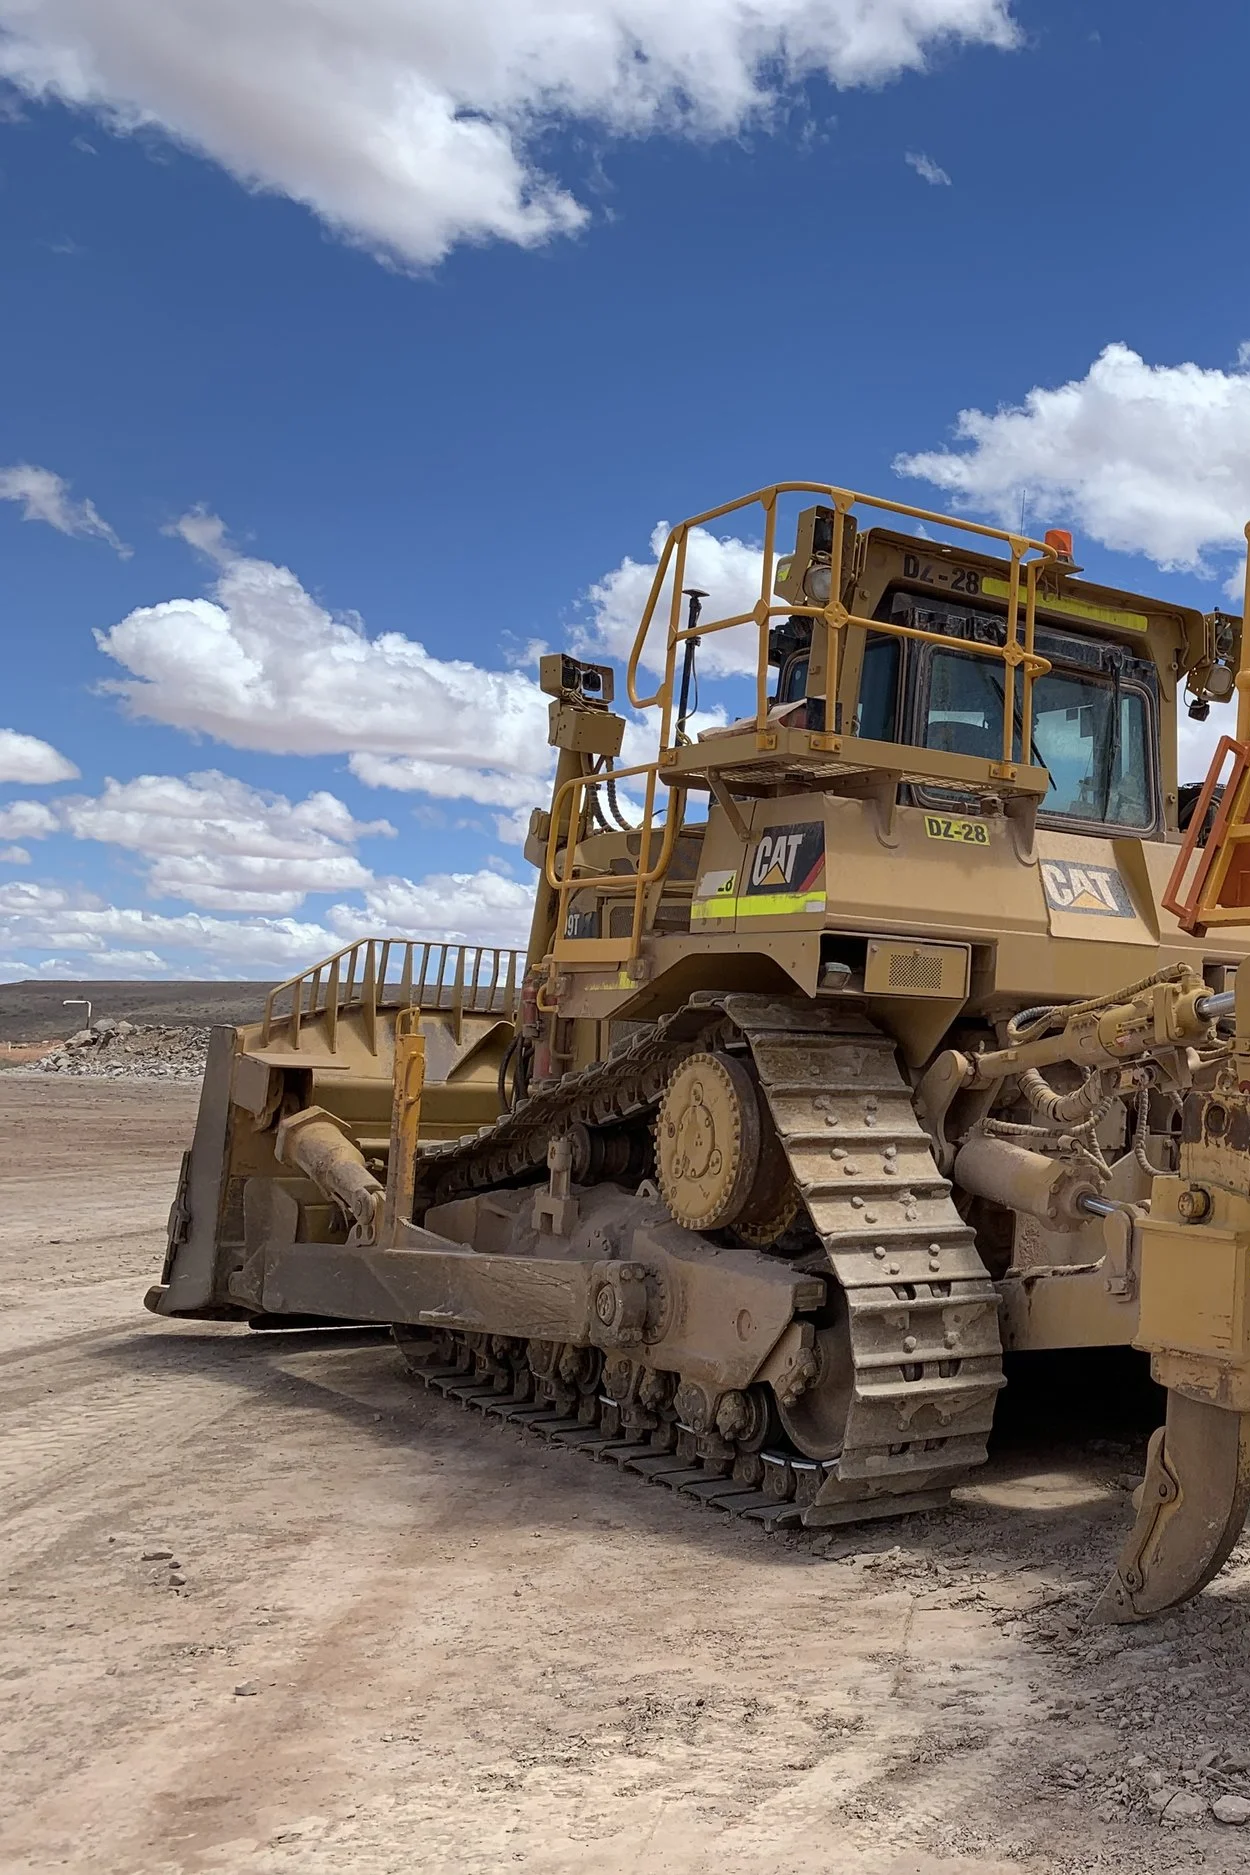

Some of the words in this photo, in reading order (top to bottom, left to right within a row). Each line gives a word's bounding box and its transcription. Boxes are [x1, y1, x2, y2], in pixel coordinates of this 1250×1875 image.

[927, 818, 987, 844] DZ-28
[752, 833, 805, 887] CAT
[1040, 863, 1120, 912] CAT
